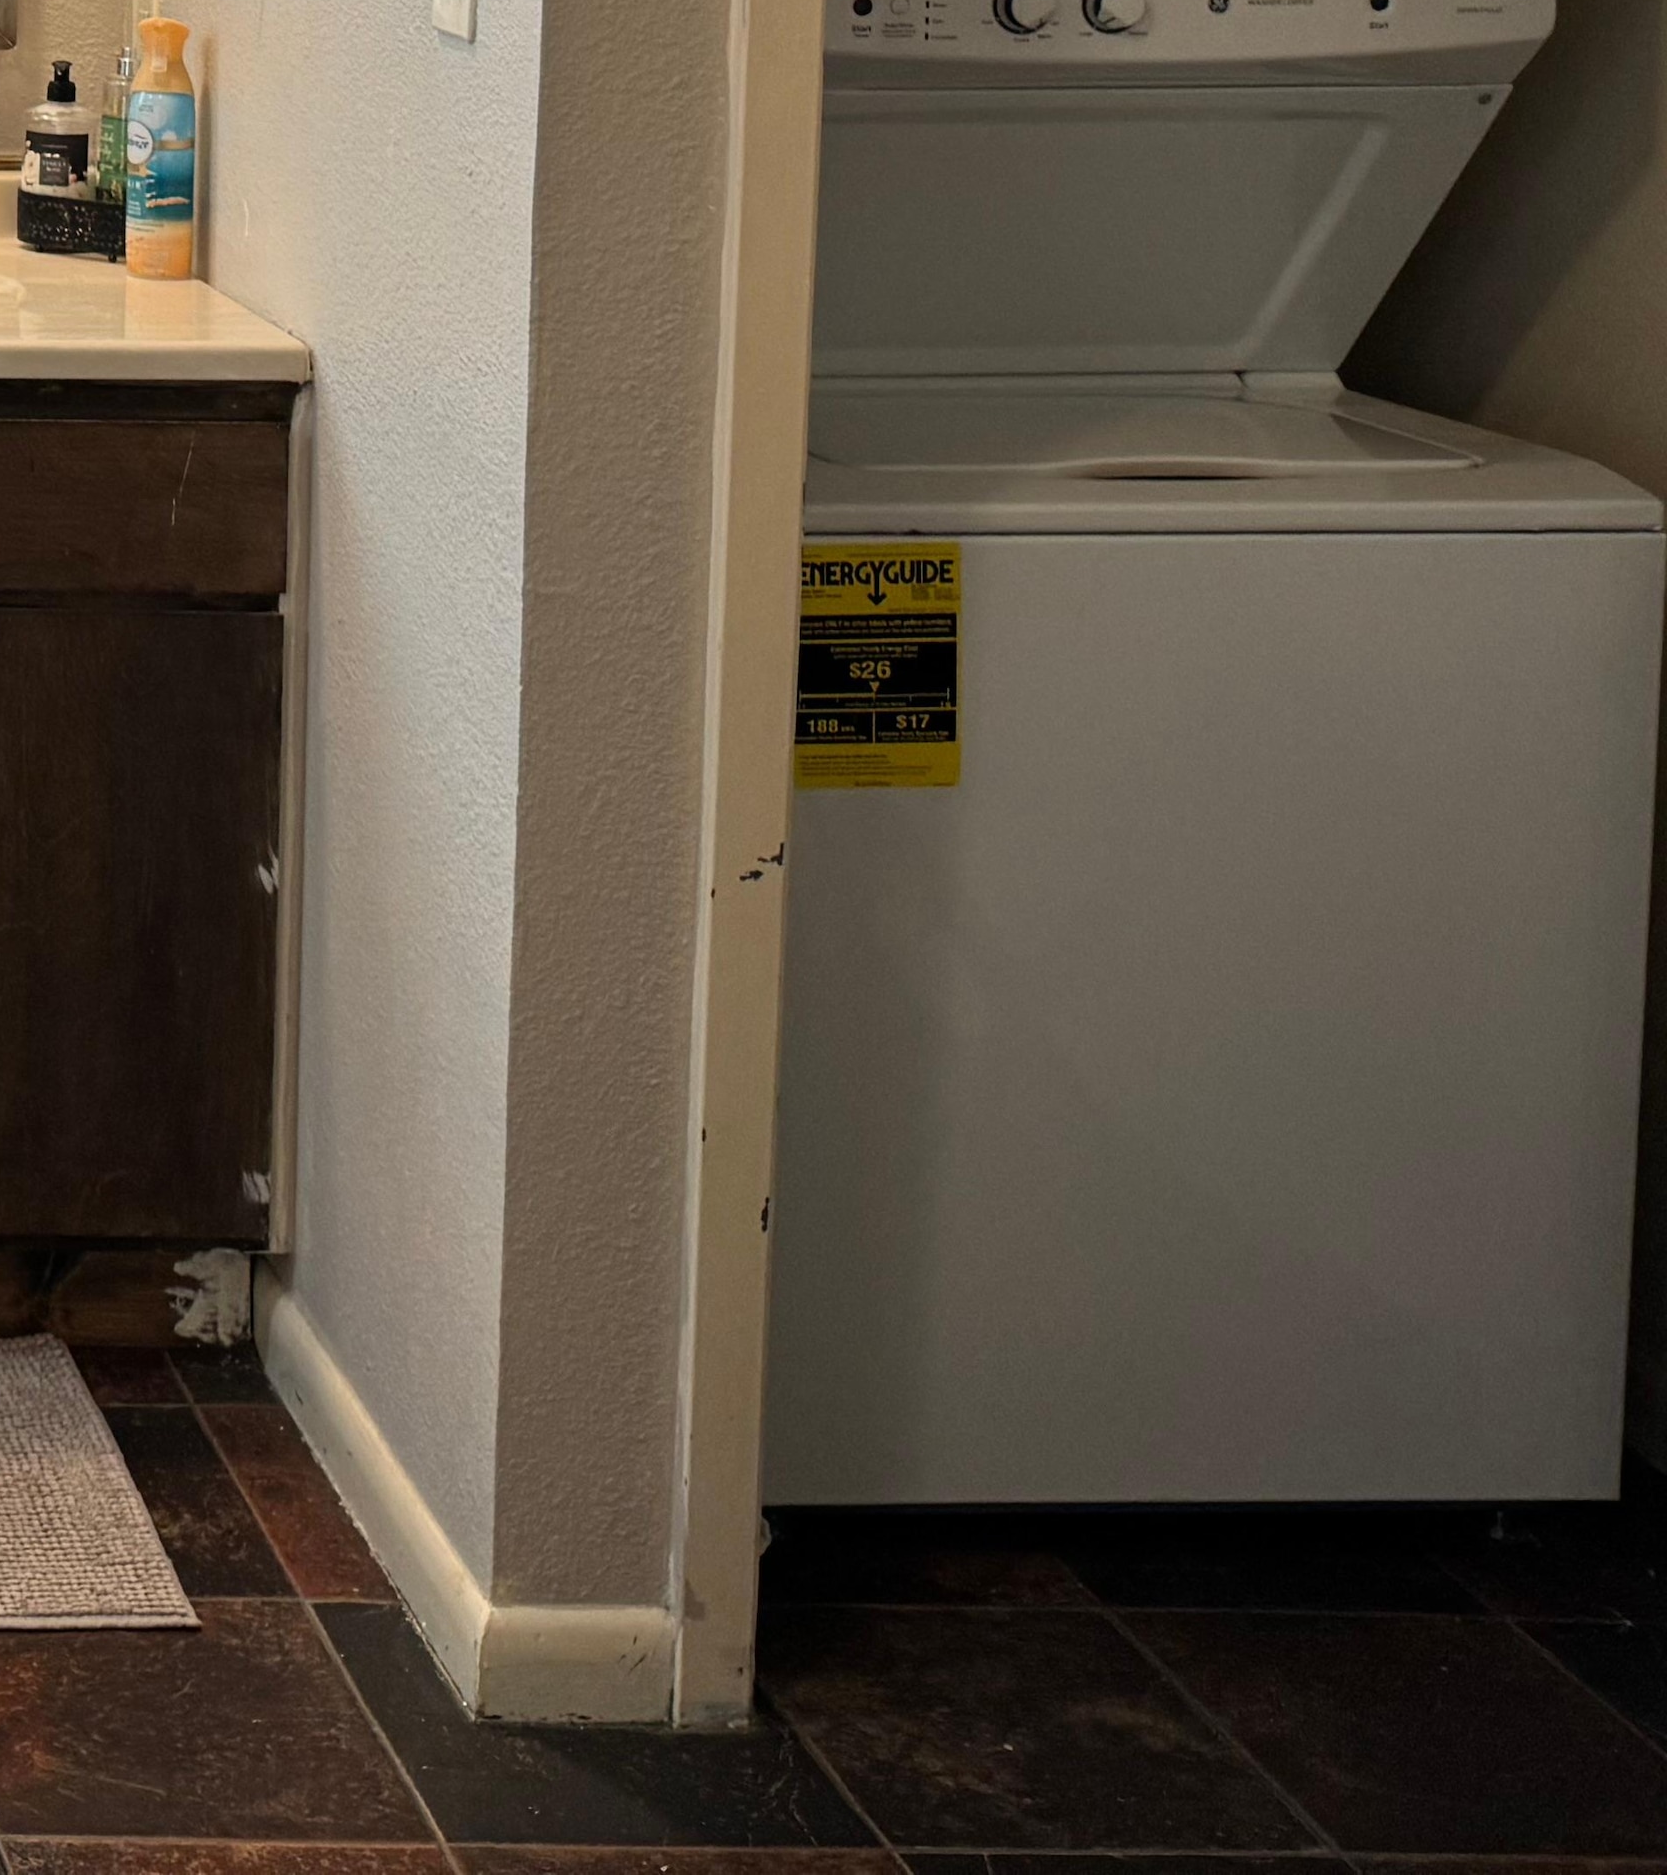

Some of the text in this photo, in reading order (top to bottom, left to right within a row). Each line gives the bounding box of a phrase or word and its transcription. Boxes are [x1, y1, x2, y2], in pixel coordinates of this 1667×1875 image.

[801, 560, 954, 586] ENERGYGUIDE
[849, 660, 891, 679] $26
[806, 719, 838, 734] 188
[896, 714, 930, 730] $17
